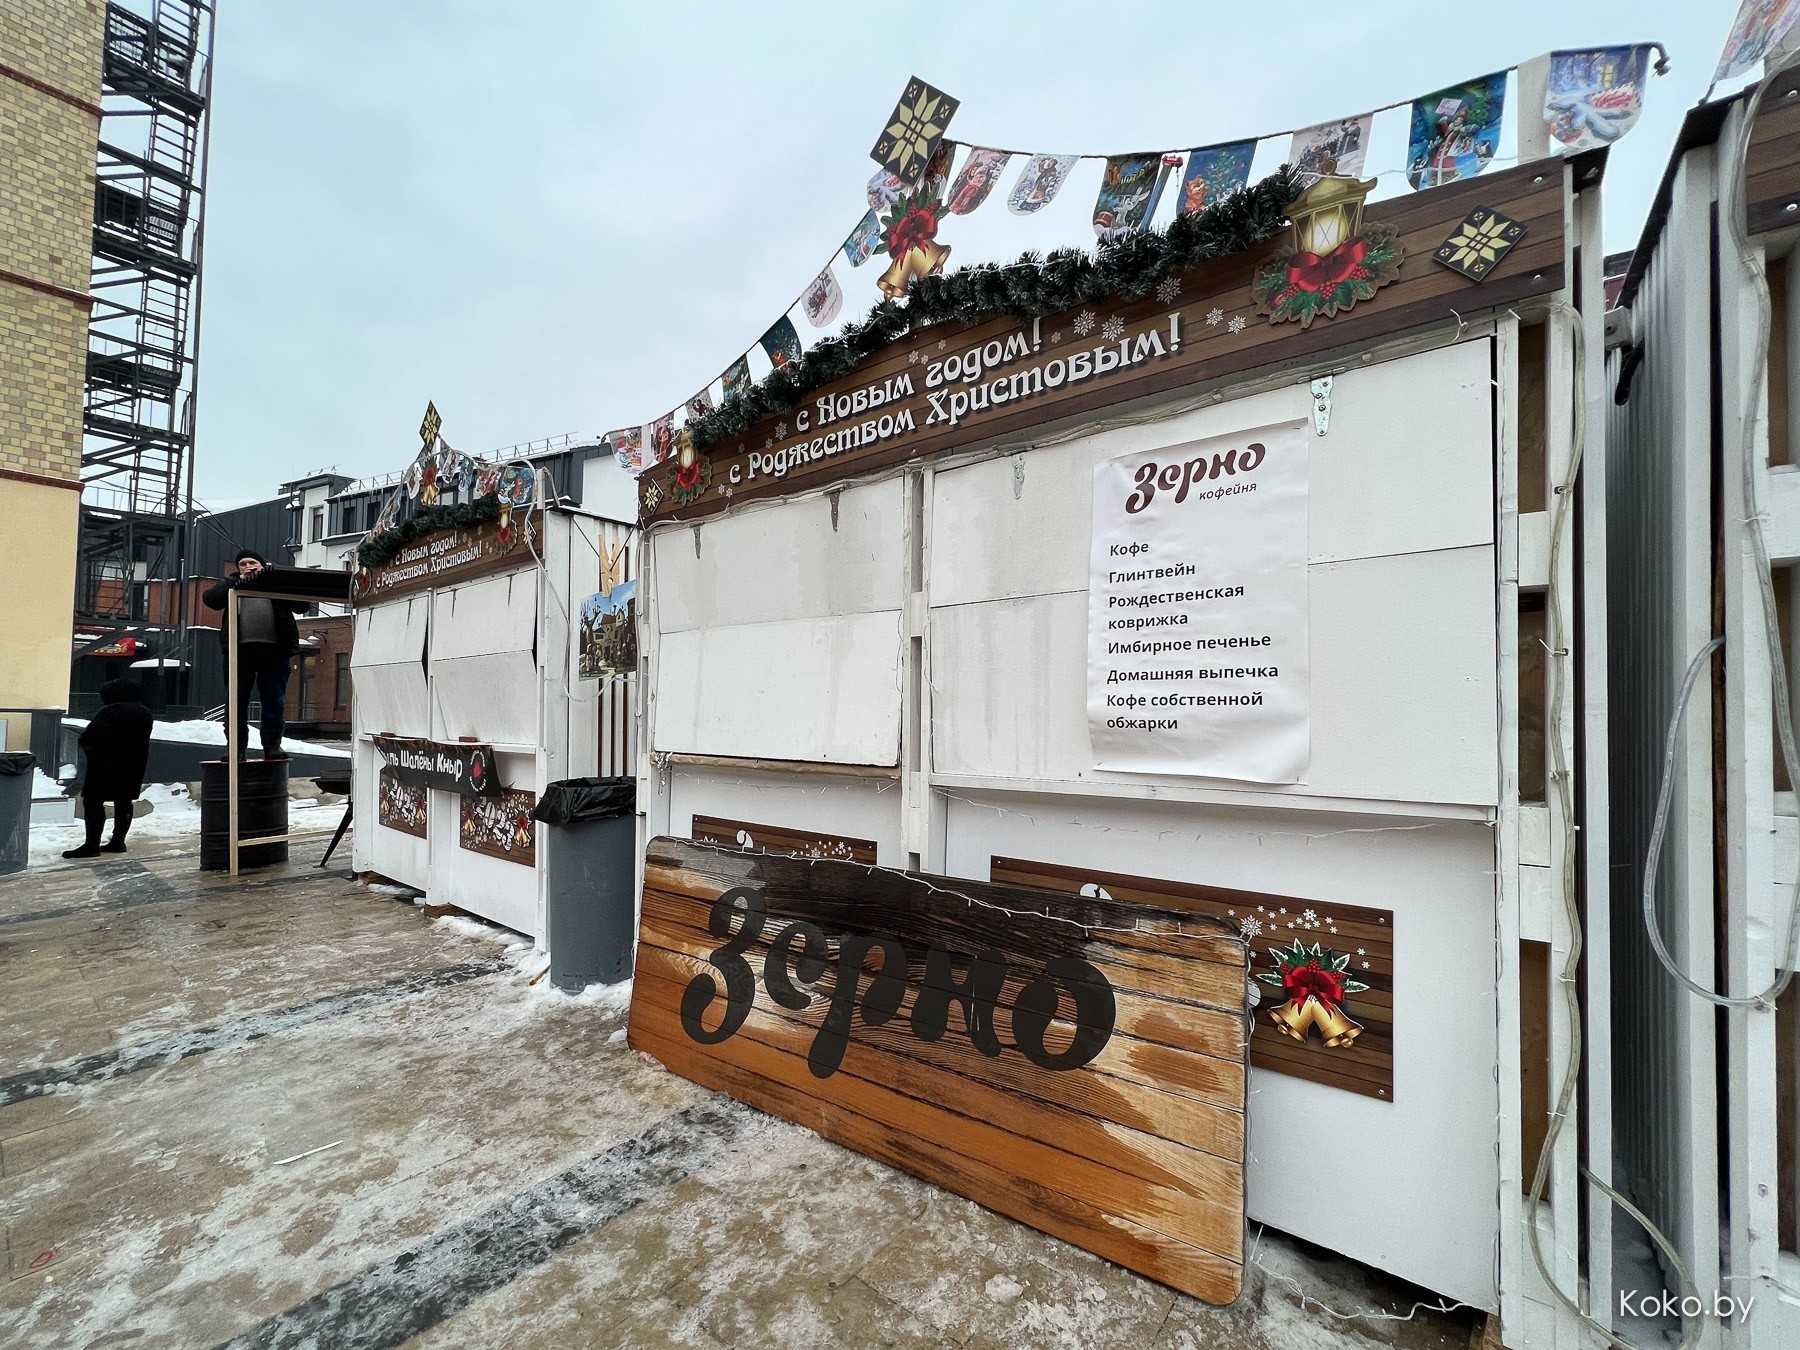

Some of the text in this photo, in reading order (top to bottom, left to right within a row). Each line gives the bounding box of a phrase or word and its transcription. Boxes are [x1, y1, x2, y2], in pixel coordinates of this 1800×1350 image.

[795, 317, 1042, 432] с Новым годом!
[728, 465, 741, 485] с
[925, 312, 1181, 427] Христовым!
[1125, 443, 1266, 514] Зерно
[1199, 482, 1257, 501] кофейня
[401, 545, 429, 563] Новым
[431, 531, 457, 555] годом!
[1110, 542, 1149, 557] Кофе
[430, 541, 482, 575] Христовым!
[1109, 563, 1195, 584] Глинтвейн
[1109, 586, 1244, 608] Рождественская
[1108, 614, 1188, 631] коврижка
[1108, 635, 1271, 655] Имбирное печенье
[1107, 666, 1279, 685] Домашняя выпечка
[1107, 692, 1263, 710] Кофе собственной
[1107, 717, 1178, 732] обжарки
[437, 753, 463, 782] Кныр
[680, 886, 1116, 1078] Зерно
